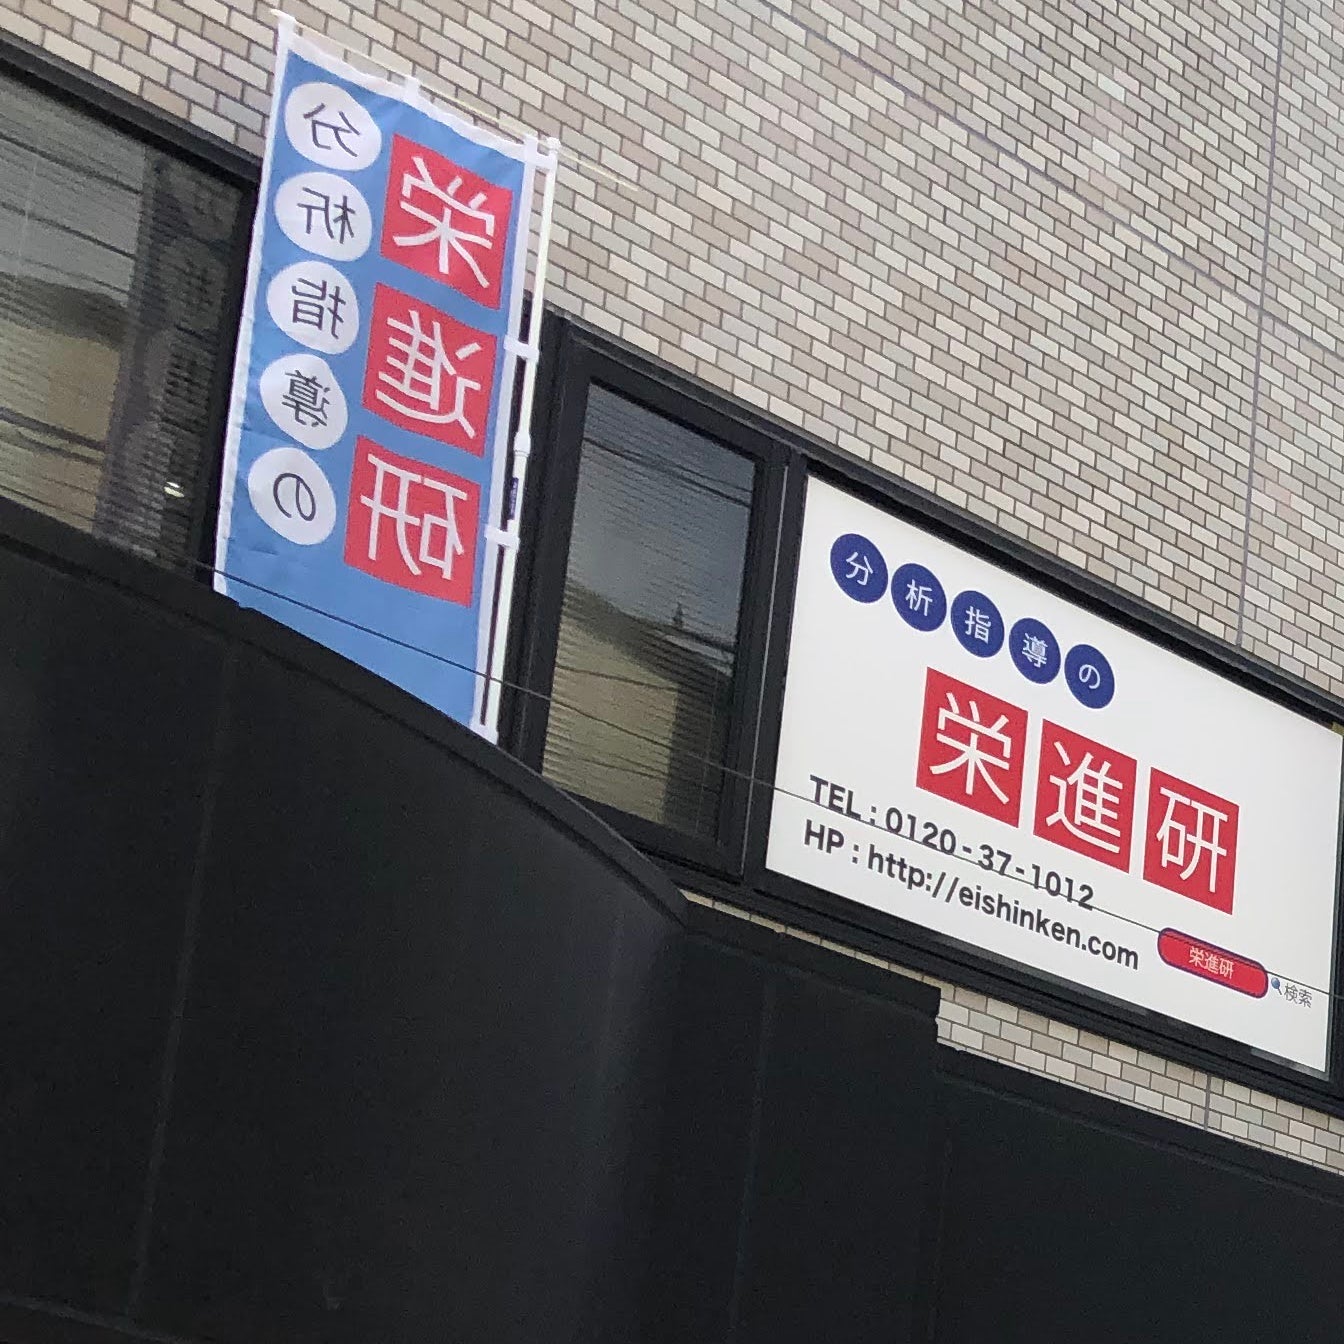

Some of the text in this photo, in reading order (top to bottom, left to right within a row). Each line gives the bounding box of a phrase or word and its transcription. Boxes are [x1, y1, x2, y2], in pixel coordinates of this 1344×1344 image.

[844, 550, 1101, 691] 分析指導の
[928, 691, 1229, 893] 栄進研
[867, 843, 1140, 971] http://eishinken.com
[1188, 946, 1234, 980] 栄進研
[1283, 983, 1313, 1009] 検索
